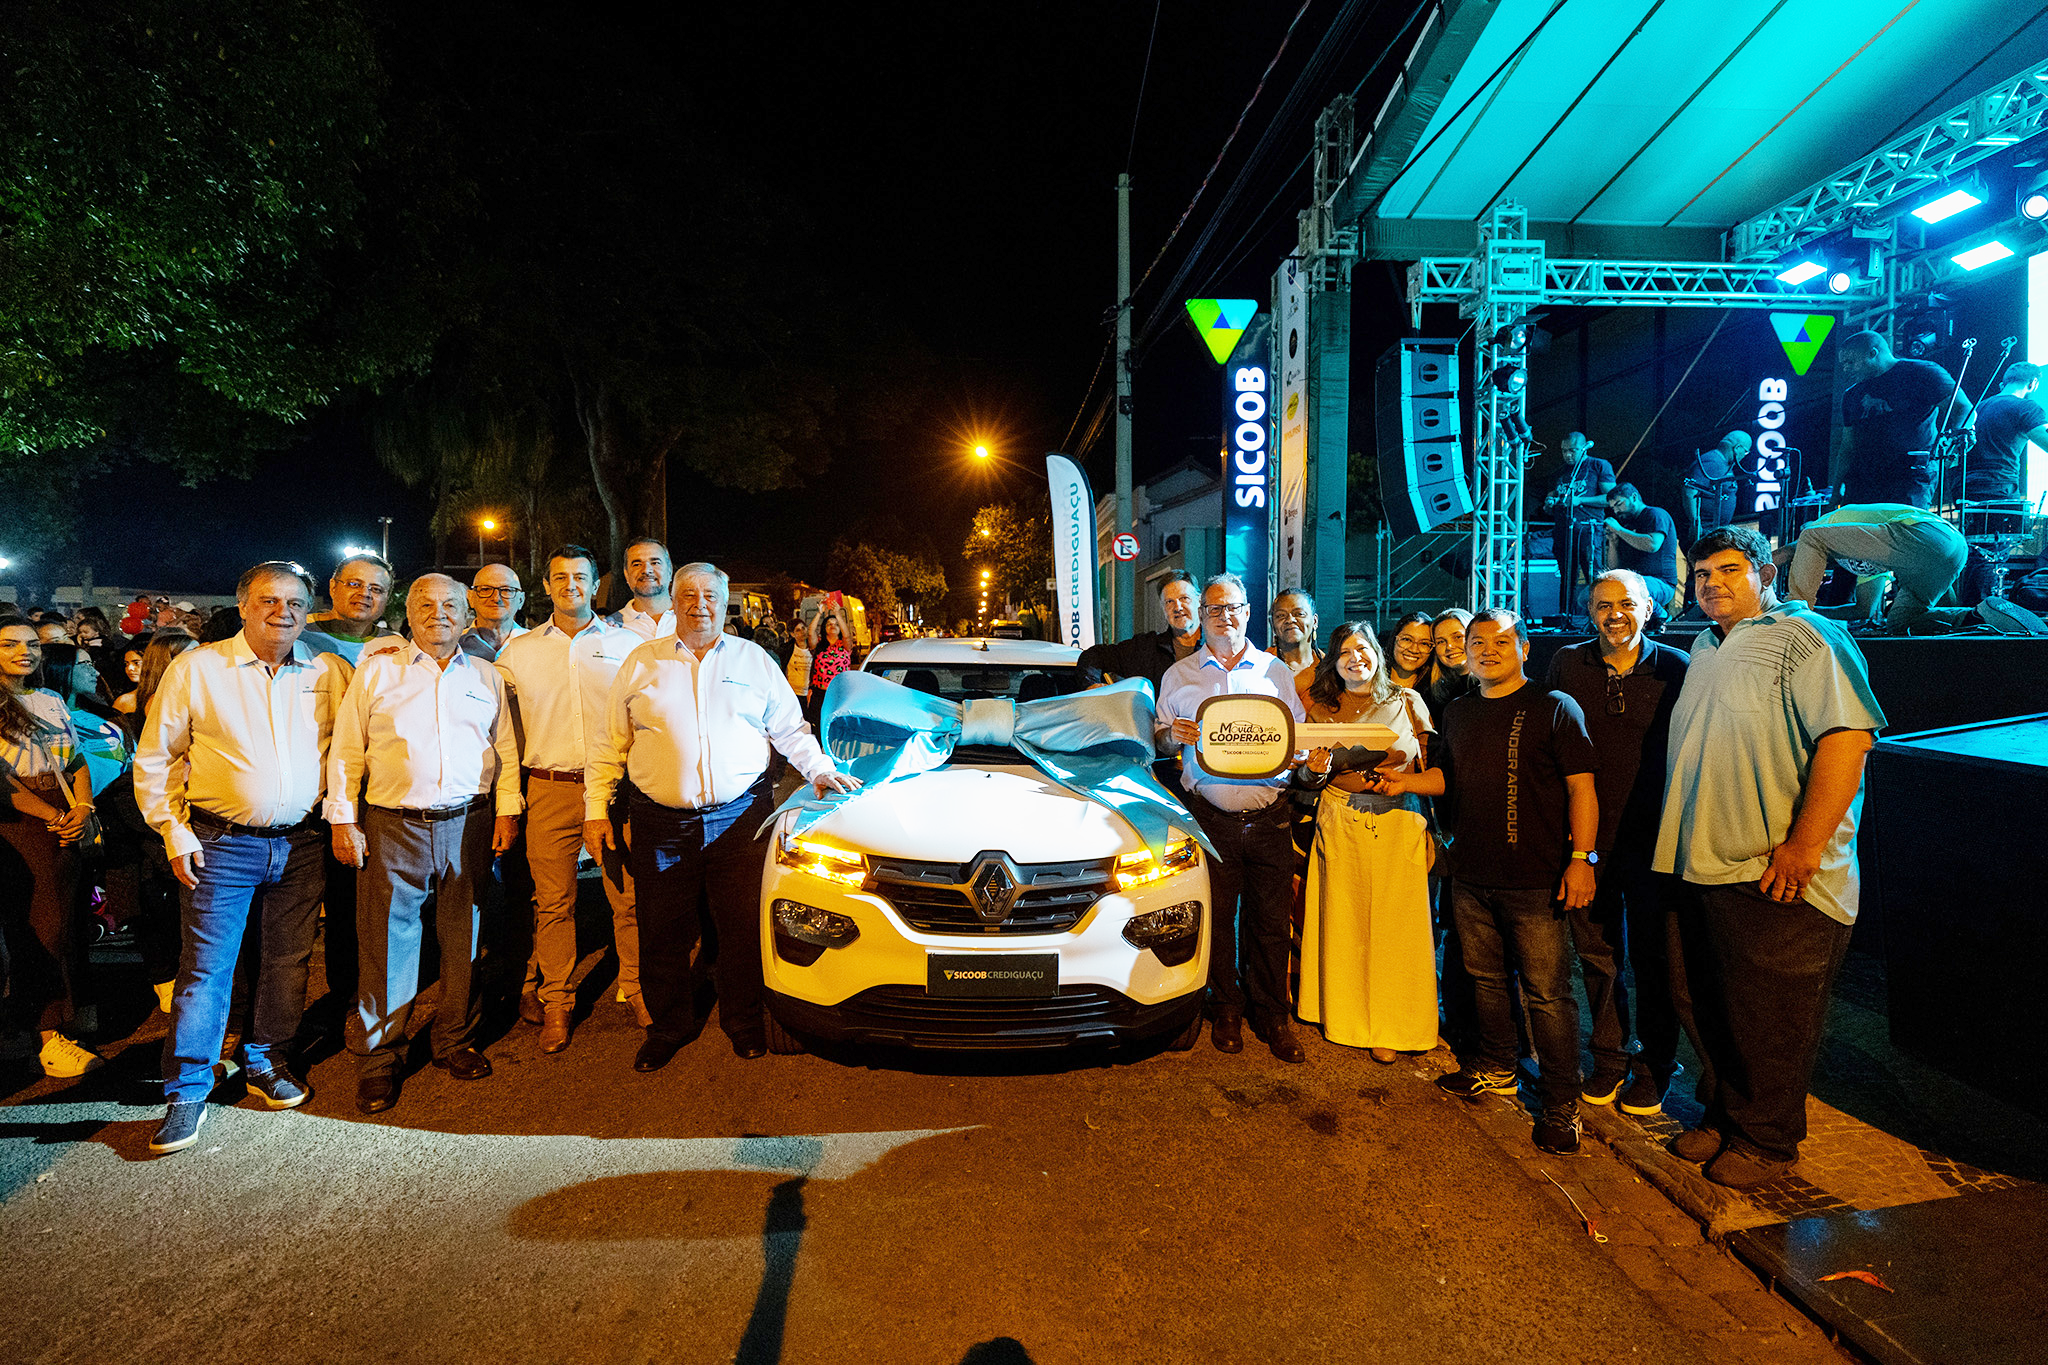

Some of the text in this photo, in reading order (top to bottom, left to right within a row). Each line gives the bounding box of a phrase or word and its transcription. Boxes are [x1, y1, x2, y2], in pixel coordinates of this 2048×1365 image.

[1235, 367, 1266, 508] SICOOB
[1209, 731, 1281, 745] COOPERAÇÃO
[1220, 722, 1264, 734] Movidos
[1507, 716, 1525, 844] UNDER ARMOUR
